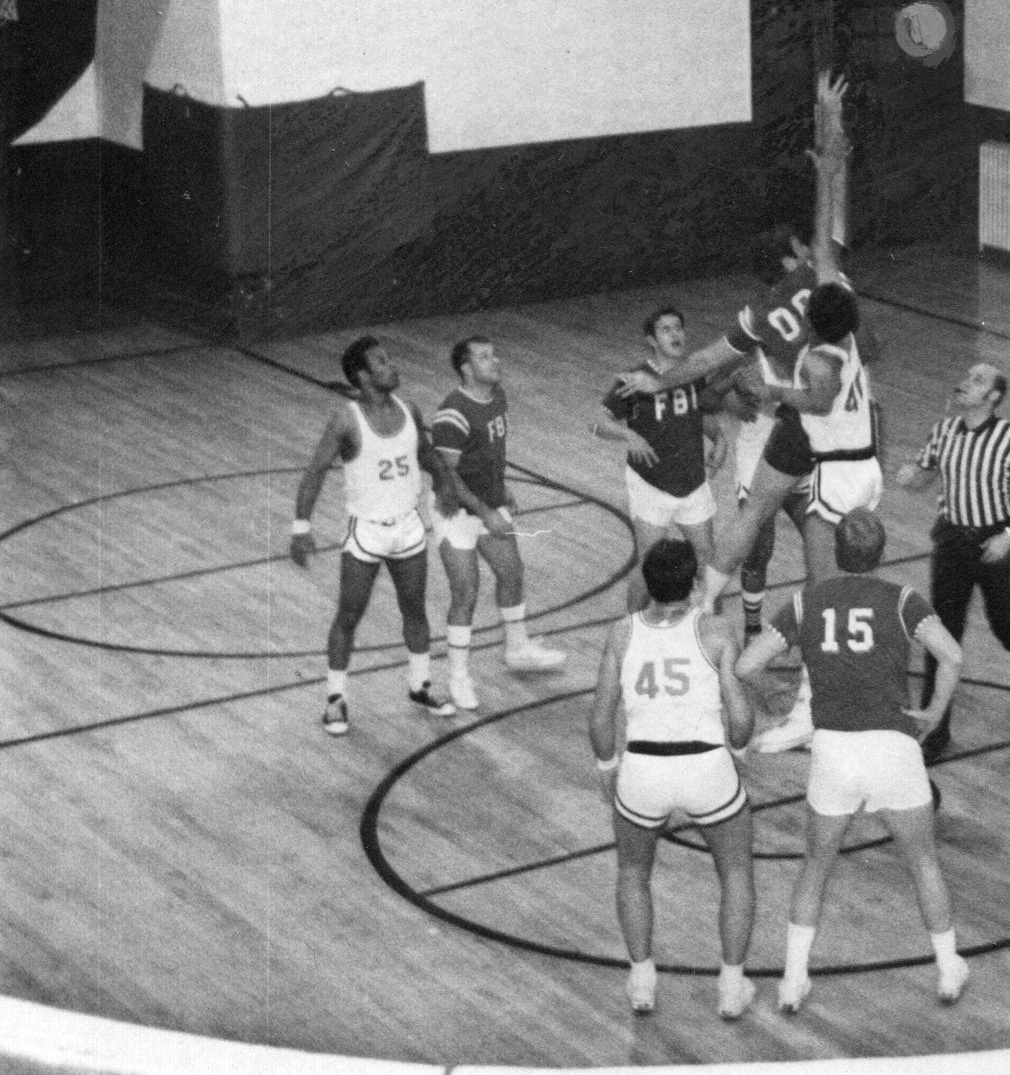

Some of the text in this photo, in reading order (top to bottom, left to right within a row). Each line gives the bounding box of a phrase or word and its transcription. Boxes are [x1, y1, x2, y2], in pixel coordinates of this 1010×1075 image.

[655, 384, 698, 420] FBI
[487, 415, 506, 442] FB
[379, 455, 410, 480] 25
[821, 608, 874, 652] 15
[634, 657, 690, 699] 45
